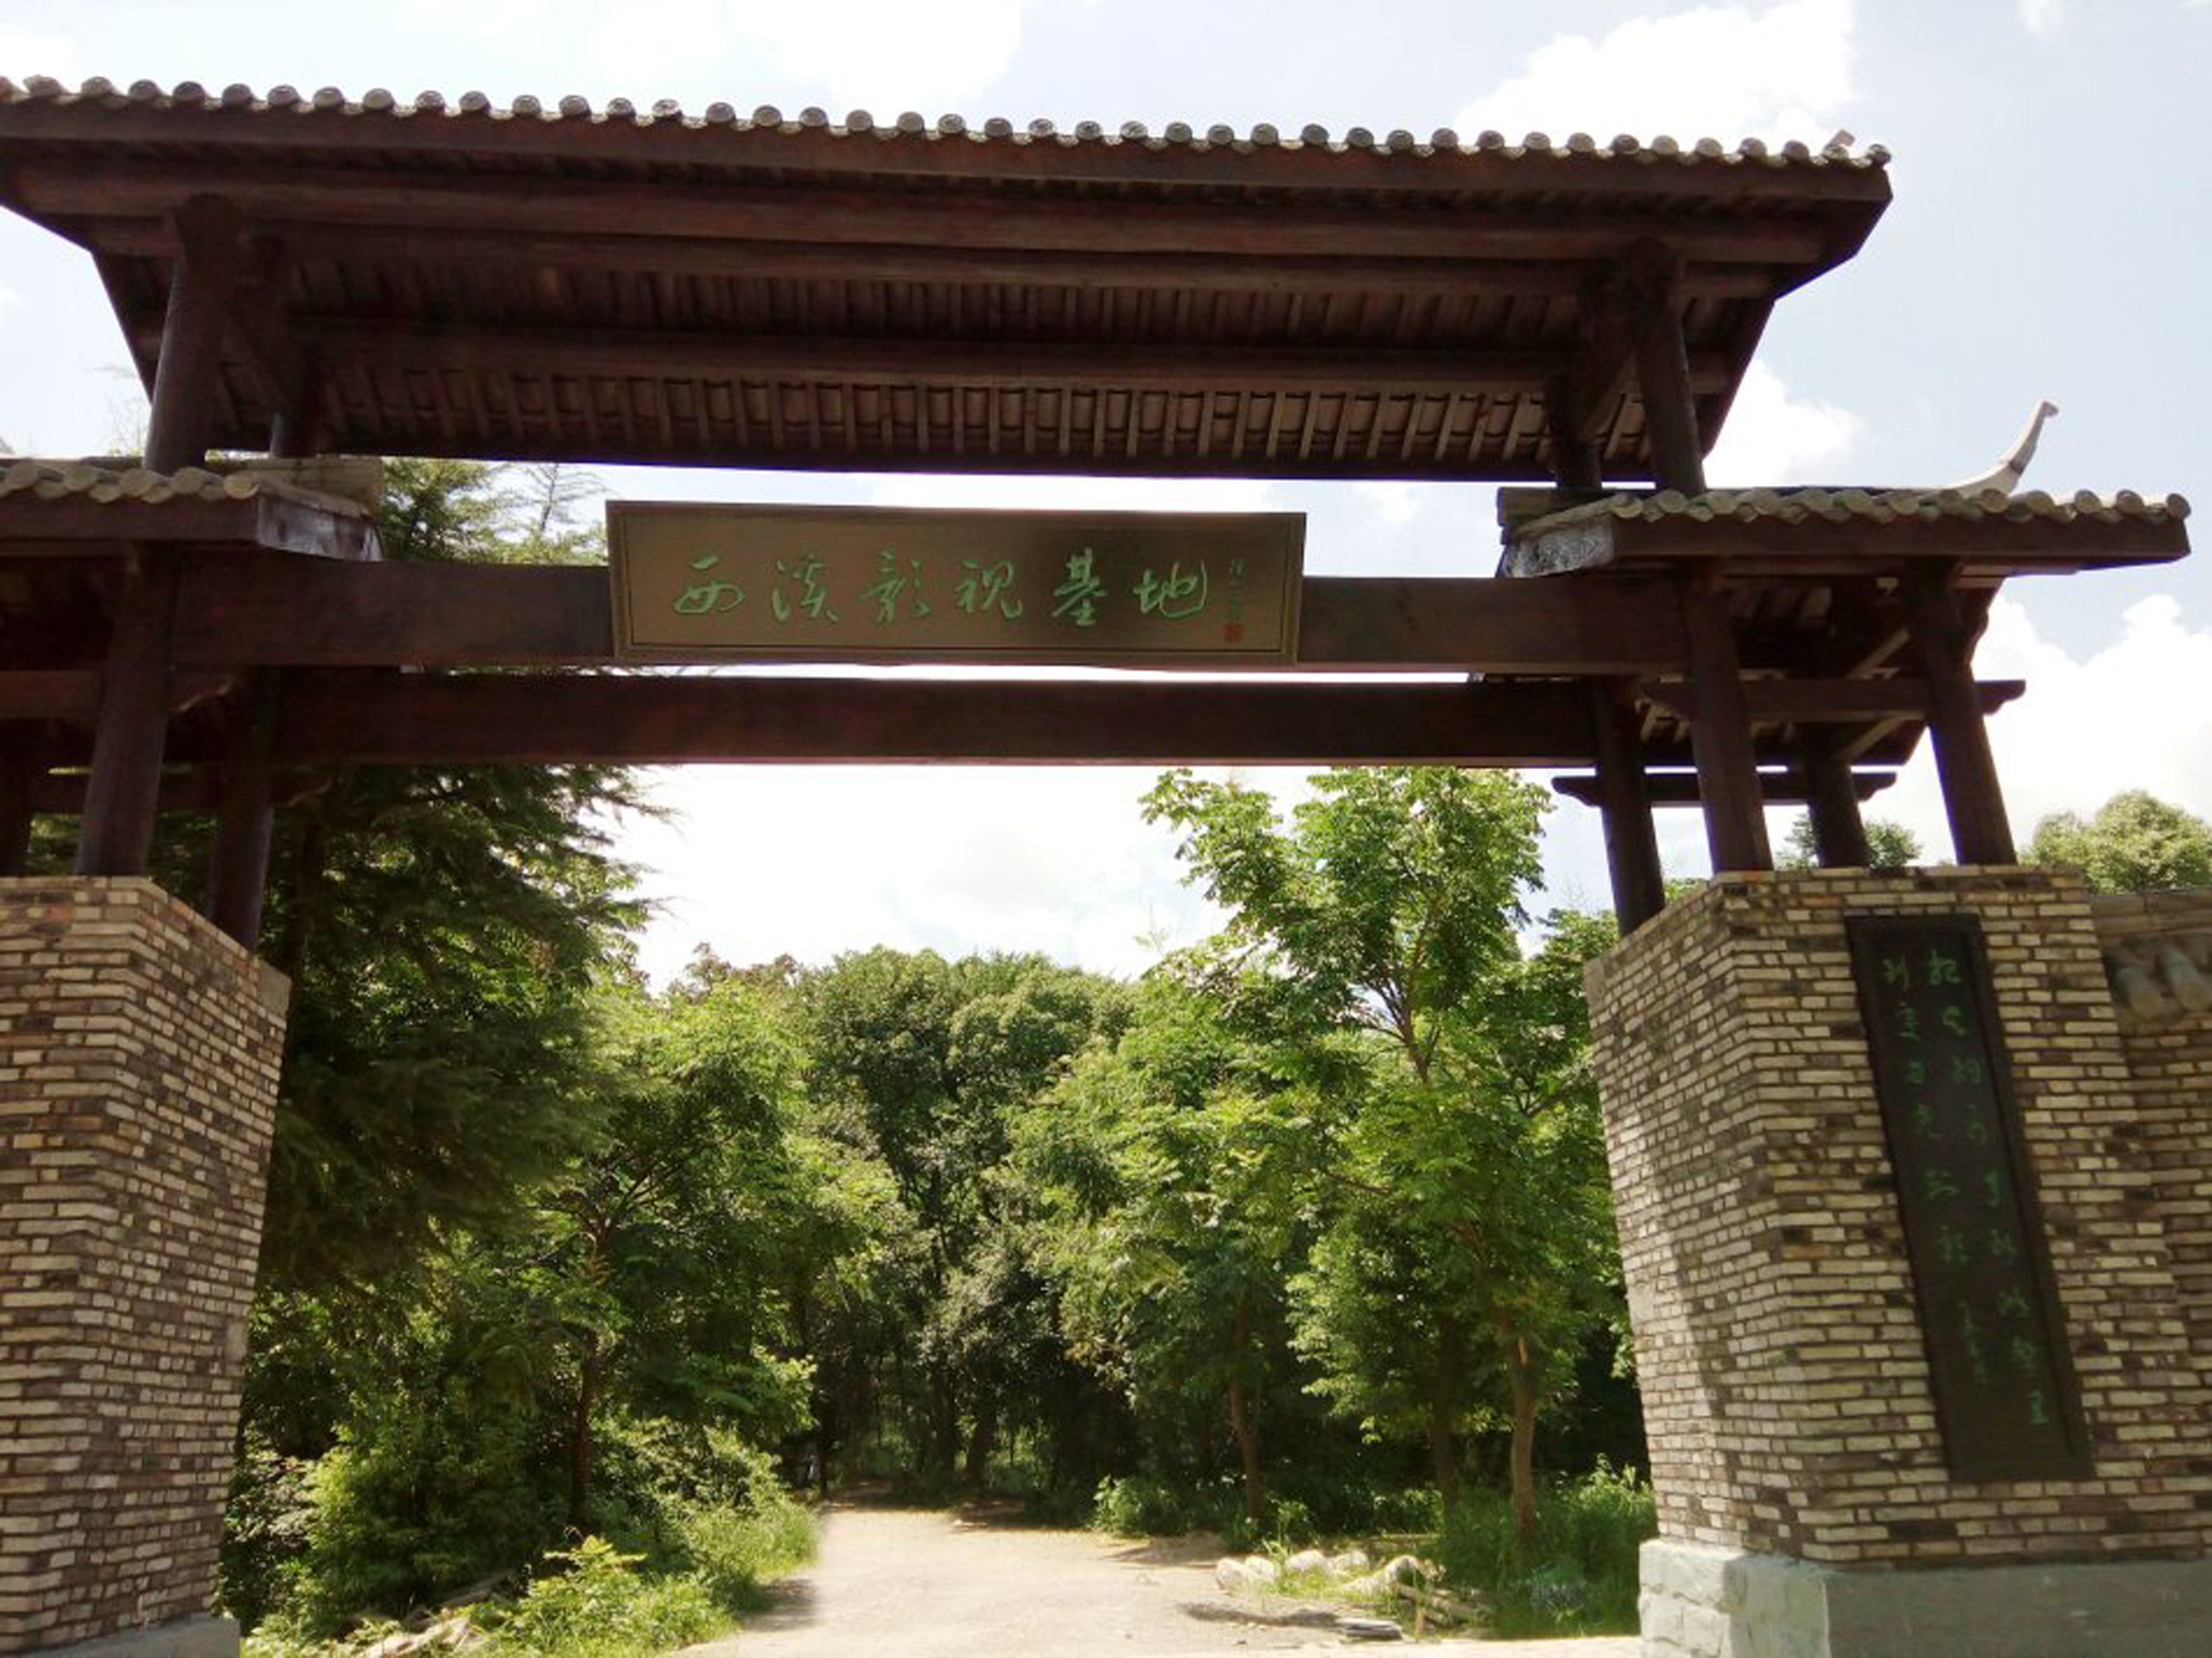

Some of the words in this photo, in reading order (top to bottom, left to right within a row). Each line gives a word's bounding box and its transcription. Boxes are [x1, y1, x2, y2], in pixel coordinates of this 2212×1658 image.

[673, 546, 1208, 626] 西溪影视基地
